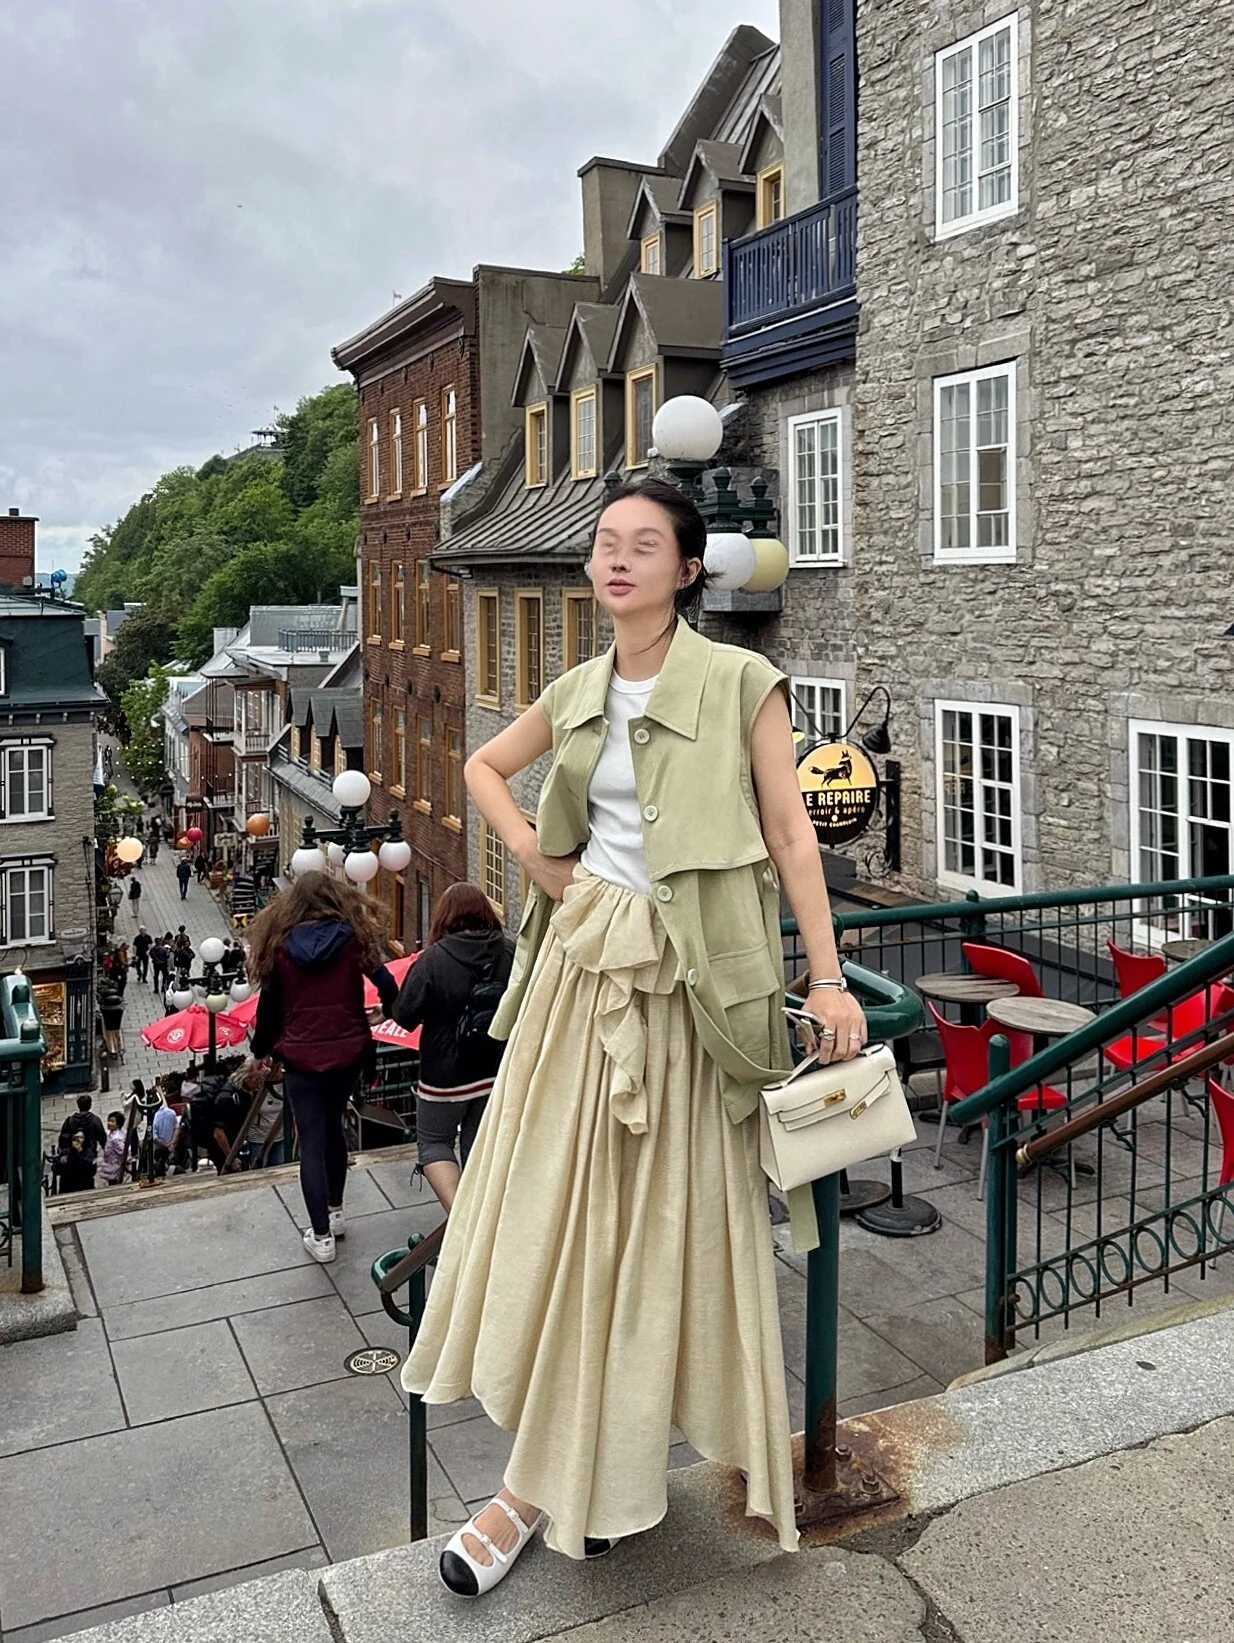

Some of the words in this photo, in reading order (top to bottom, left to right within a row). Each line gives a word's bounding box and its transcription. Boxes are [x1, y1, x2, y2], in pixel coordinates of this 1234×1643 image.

[806, 793, 813, 806] E
[818, 790, 871, 805] REPAIRE
[808, 806, 831, 816] erroir
